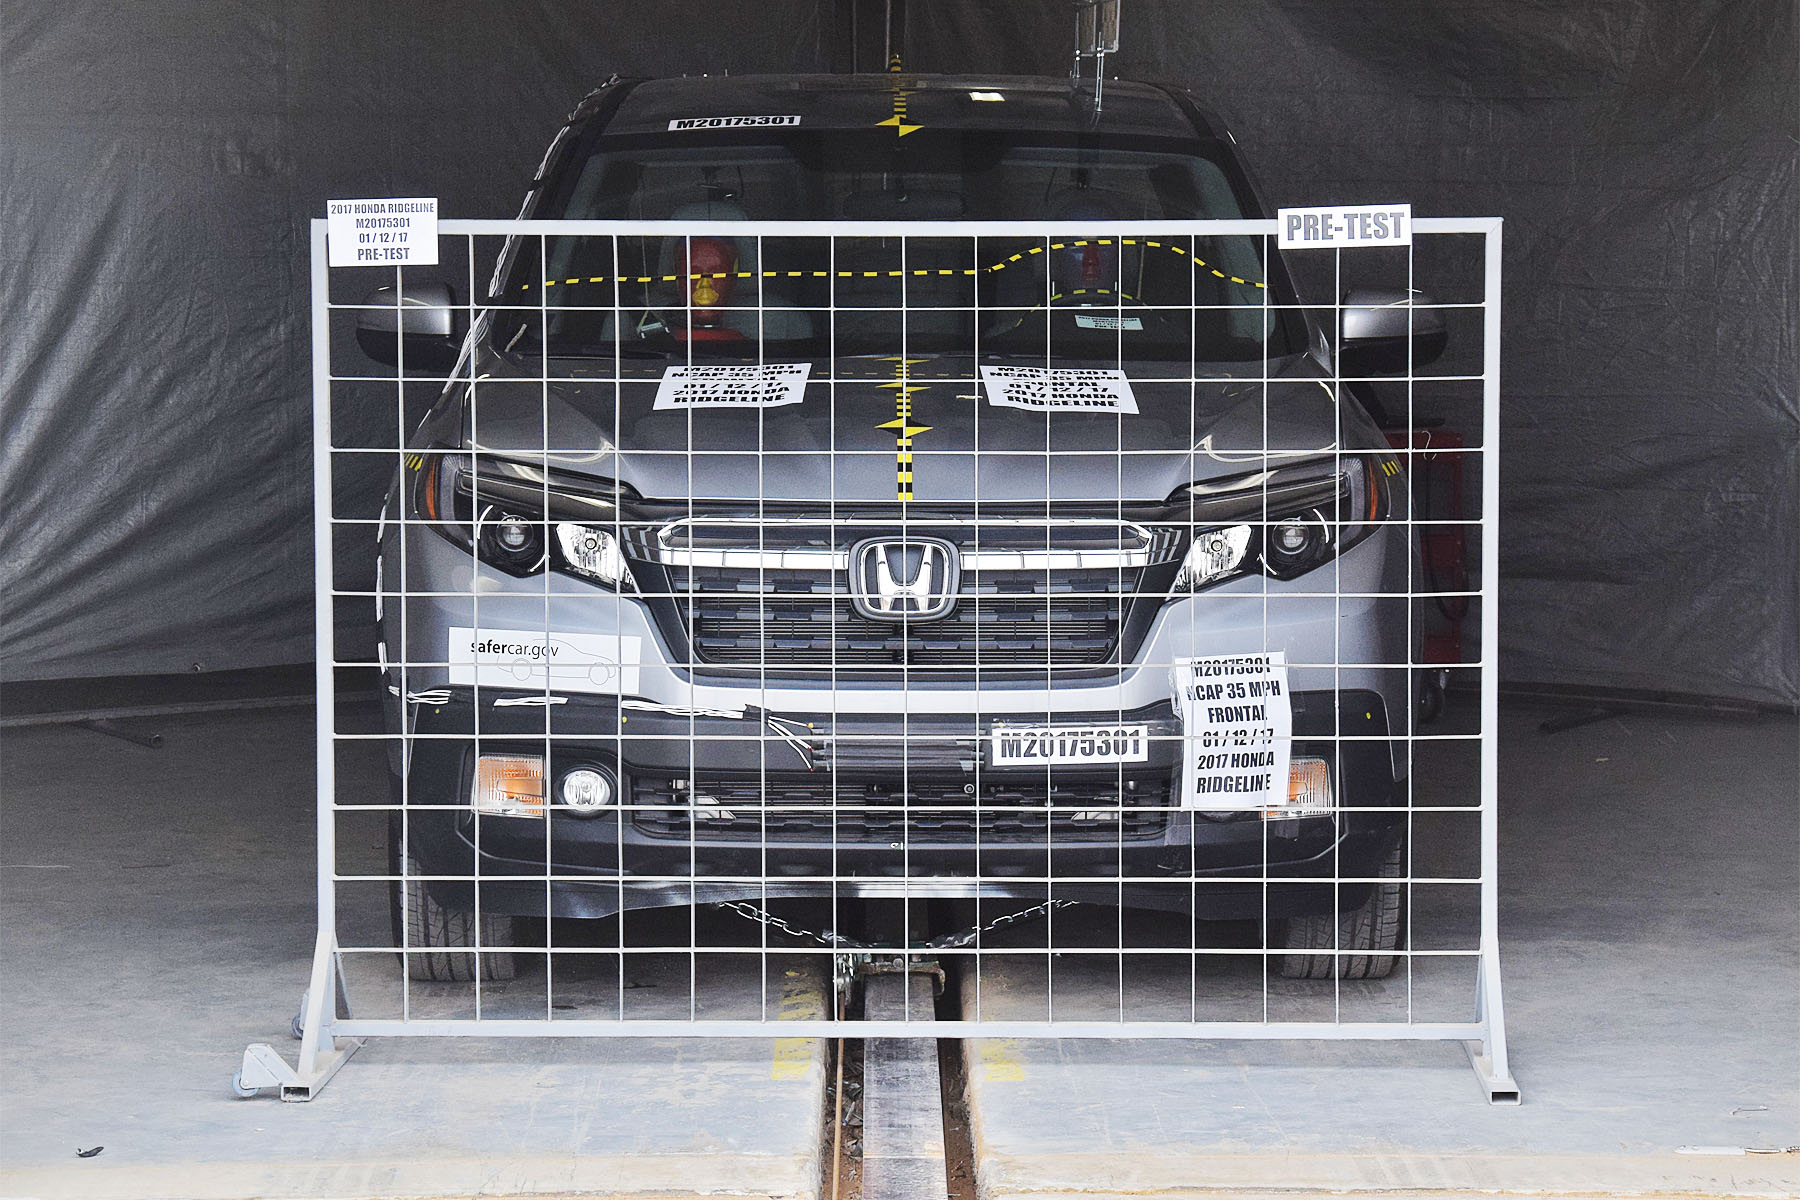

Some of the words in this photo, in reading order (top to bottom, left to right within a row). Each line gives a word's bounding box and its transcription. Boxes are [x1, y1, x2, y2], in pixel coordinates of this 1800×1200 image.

[676, 116, 795, 129] M20175301
[330, 204, 353, 215] 2017
[354, 203, 386, 214] HONDA
[388, 203, 434, 213] RIDGELINE
[356, 218, 410, 229] M20175301
[1286, 212, 1405, 241] PRE-TEST
[357, 247, 410, 261] PRE-TEST
[673, 393, 785, 403] RIDGELINE
[470, 639, 559, 660] safercar.gov
[1190, 657, 1271, 678] M20175301
[1226, 682, 1246, 699] 35
[1248, 680, 1281, 698] MPH
[1000, 728, 1140, 758] M20175301
[1197, 753, 1229, 770] 2017
[1230, 751, 1274, 769] HONDA
[1196, 773, 1271, 794] RIDGELINE
